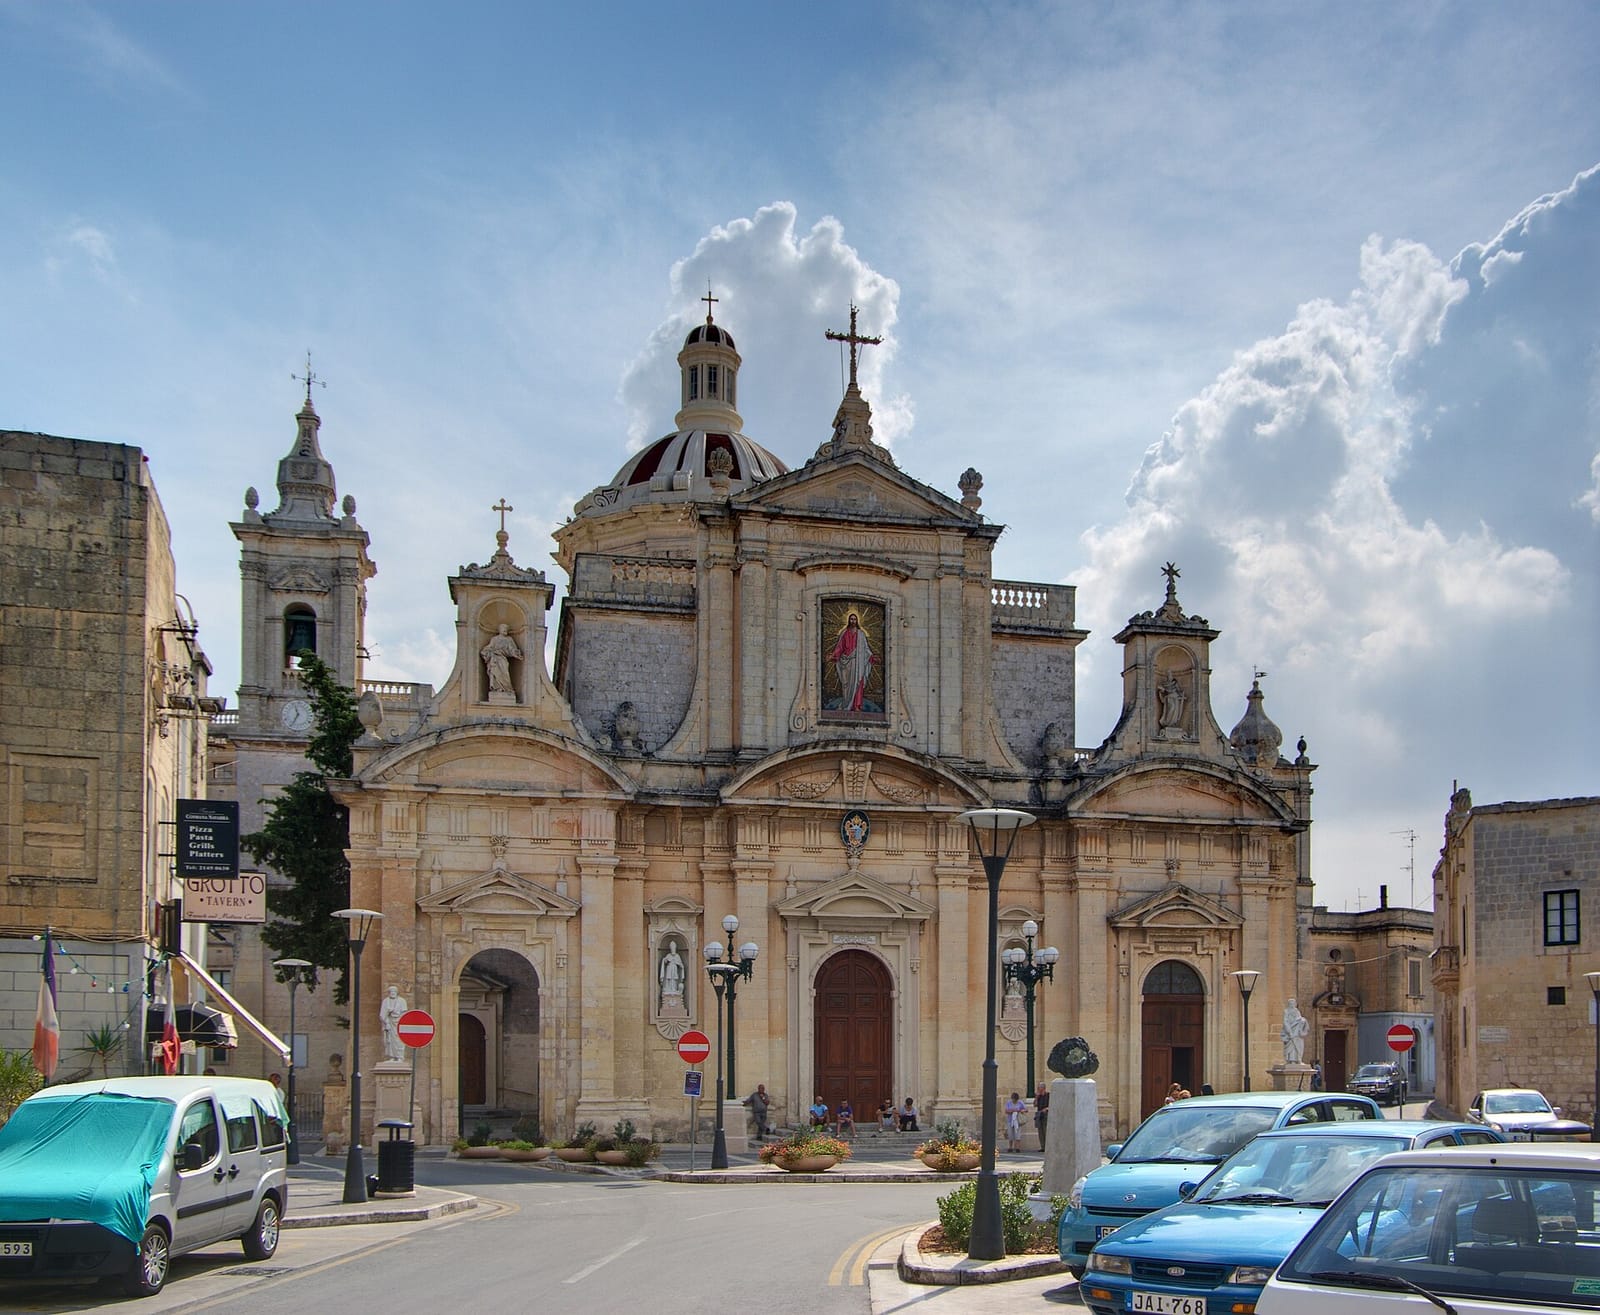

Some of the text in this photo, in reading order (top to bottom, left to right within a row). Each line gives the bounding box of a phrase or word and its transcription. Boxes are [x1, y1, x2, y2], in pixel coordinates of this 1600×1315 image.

[189, 825, 213, 833] Pizza
[189, 833, 214, 841] Pasta
[189, 841, 215, 849] Grills
[189, 850, 224, 858] Platters
[206, 896, 246, 907] TAVERN
[4, 1243, 30, 1255] 593
